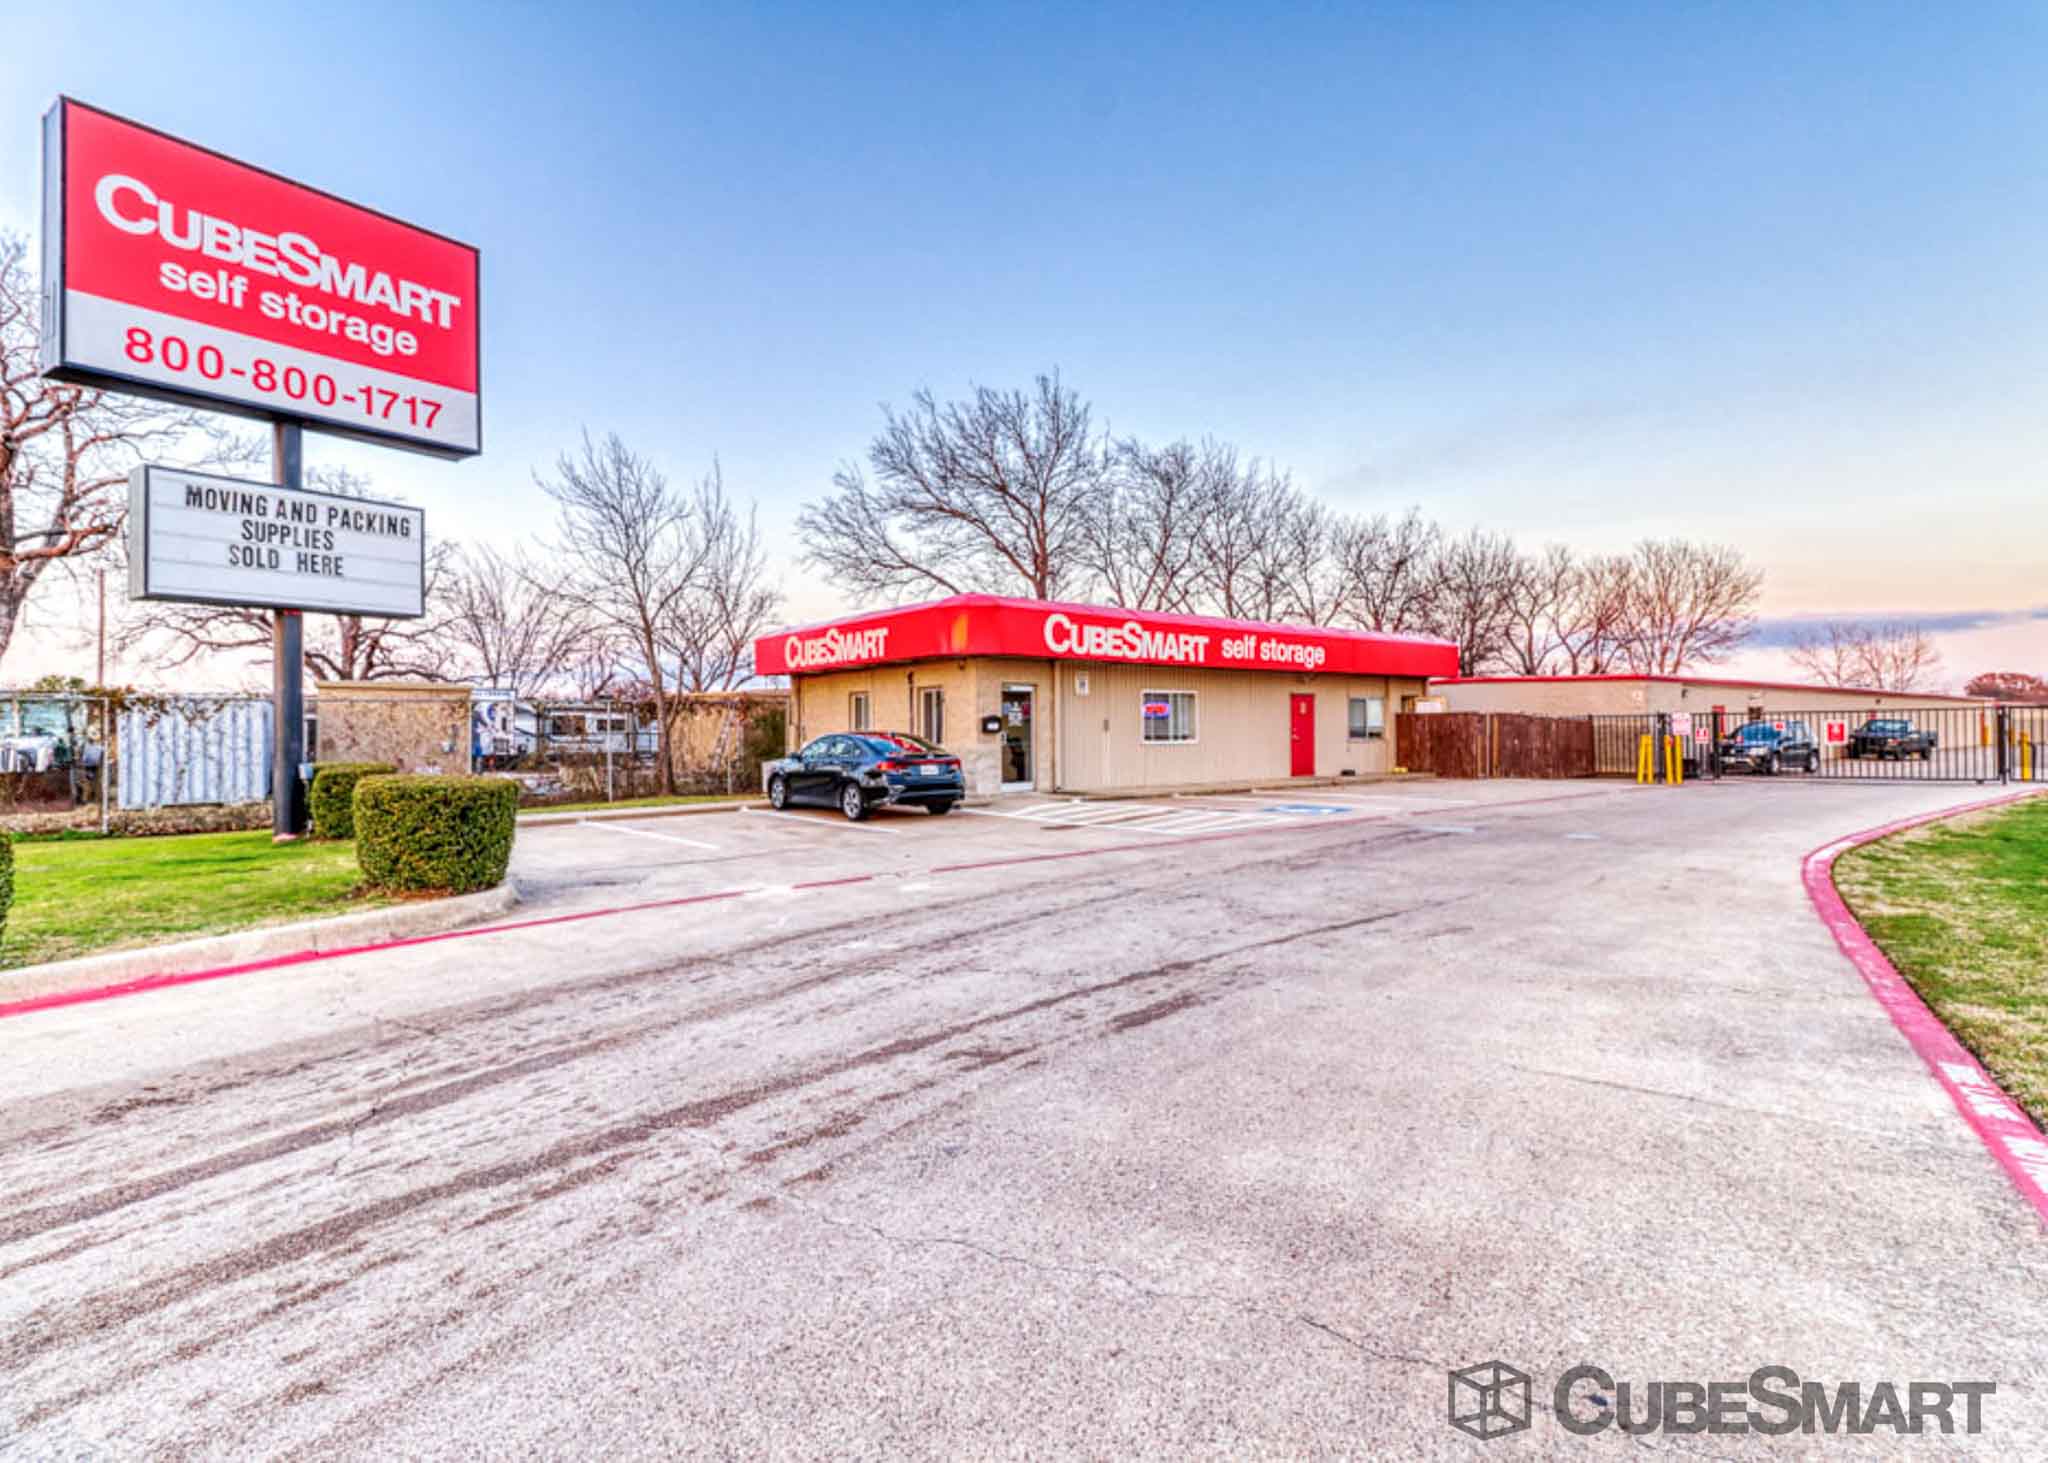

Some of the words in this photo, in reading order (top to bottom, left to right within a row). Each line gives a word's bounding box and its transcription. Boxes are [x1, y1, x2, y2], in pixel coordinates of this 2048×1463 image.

[160, 260, 249, 308] self
[259, 289, 418, 357] storage
[124, 327, 443, 429] 800-800-1717
[185, 484, 268, 517] MOVING
[275, 498, 317, 524] AND
[328, 507, 411, 538] PACKING
[241, 519, 335, 551] SUPPLIES
[229, 544, 280, 570] SOLD
[297, 552, 345, 577] HERE
[1221, 633, 1258, 661] self
[1259, 637, 1326, 668] storage
